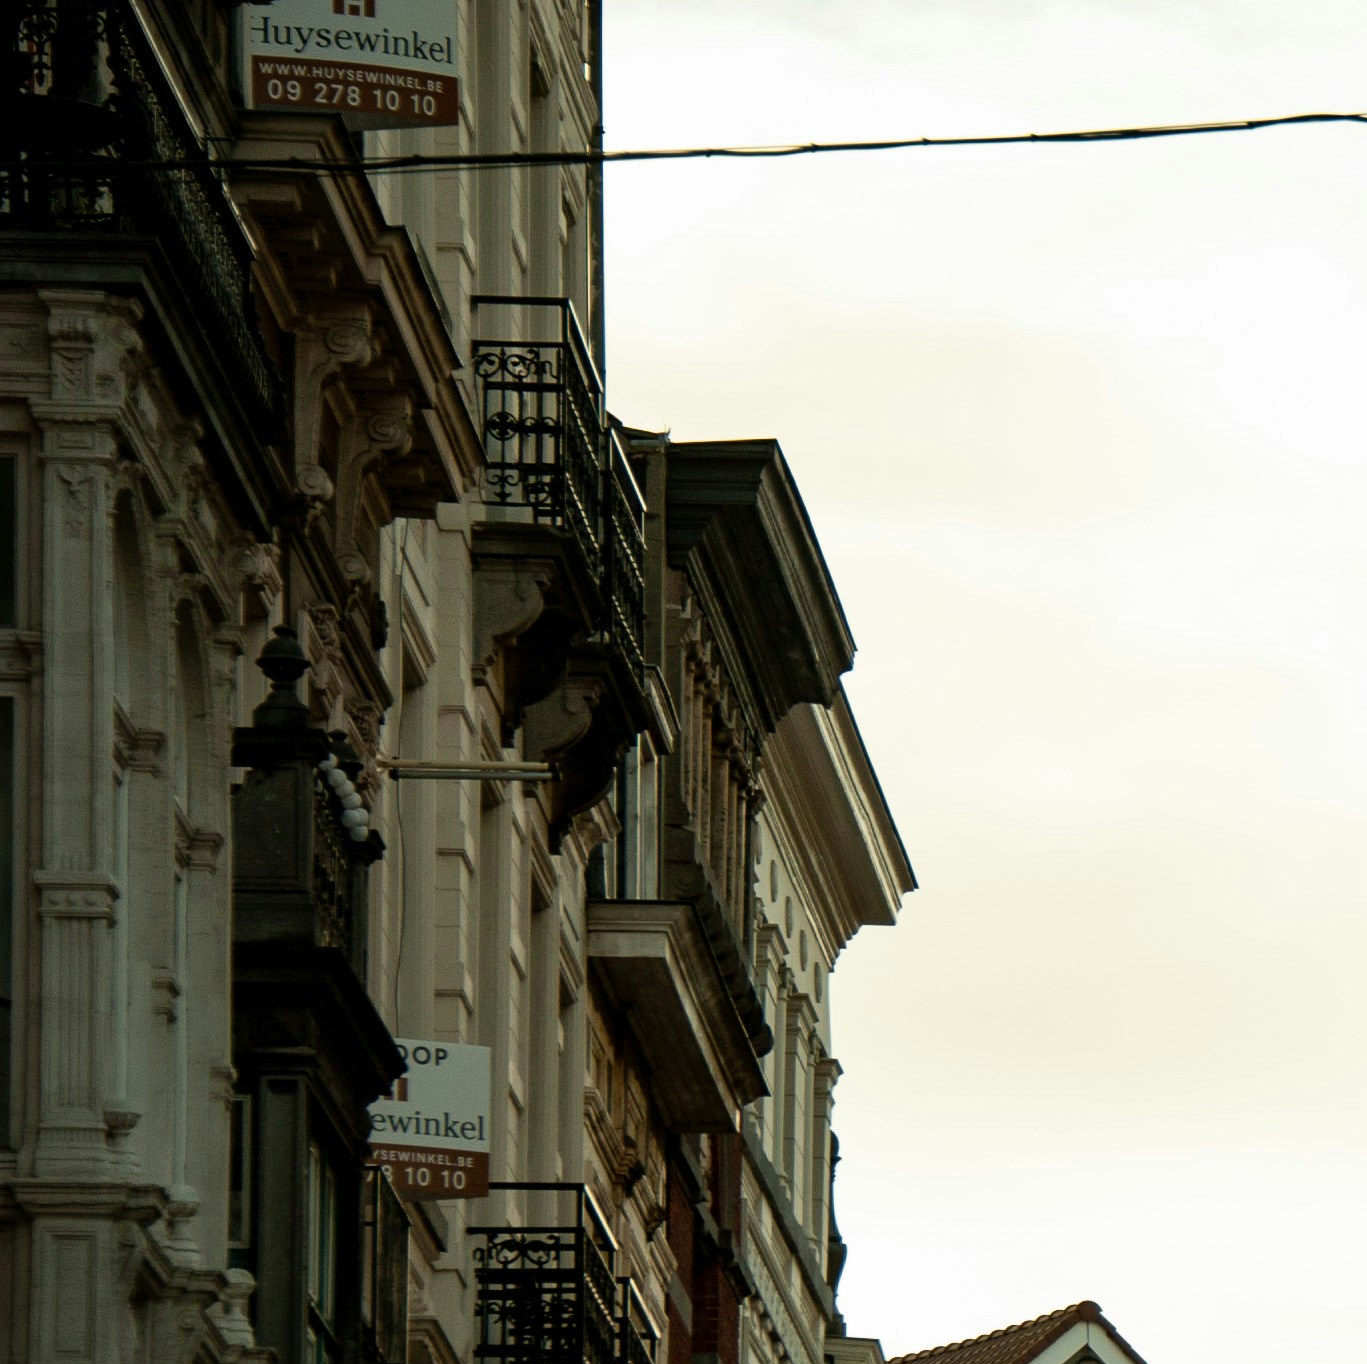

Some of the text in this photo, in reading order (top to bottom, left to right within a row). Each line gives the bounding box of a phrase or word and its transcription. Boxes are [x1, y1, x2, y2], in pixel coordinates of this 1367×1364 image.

[251, 16, 453, 65] Huysewinkel
[258, 62, 445, 94] WWW.HUYSEWINKEL.BE
[267, 78, 437, 117] 09 278 10 10
[371, 1110, 485, 1141] ewinkel
[404, 1166, 431, 1187] 10
[441, 1170, 467, 1190] 10
